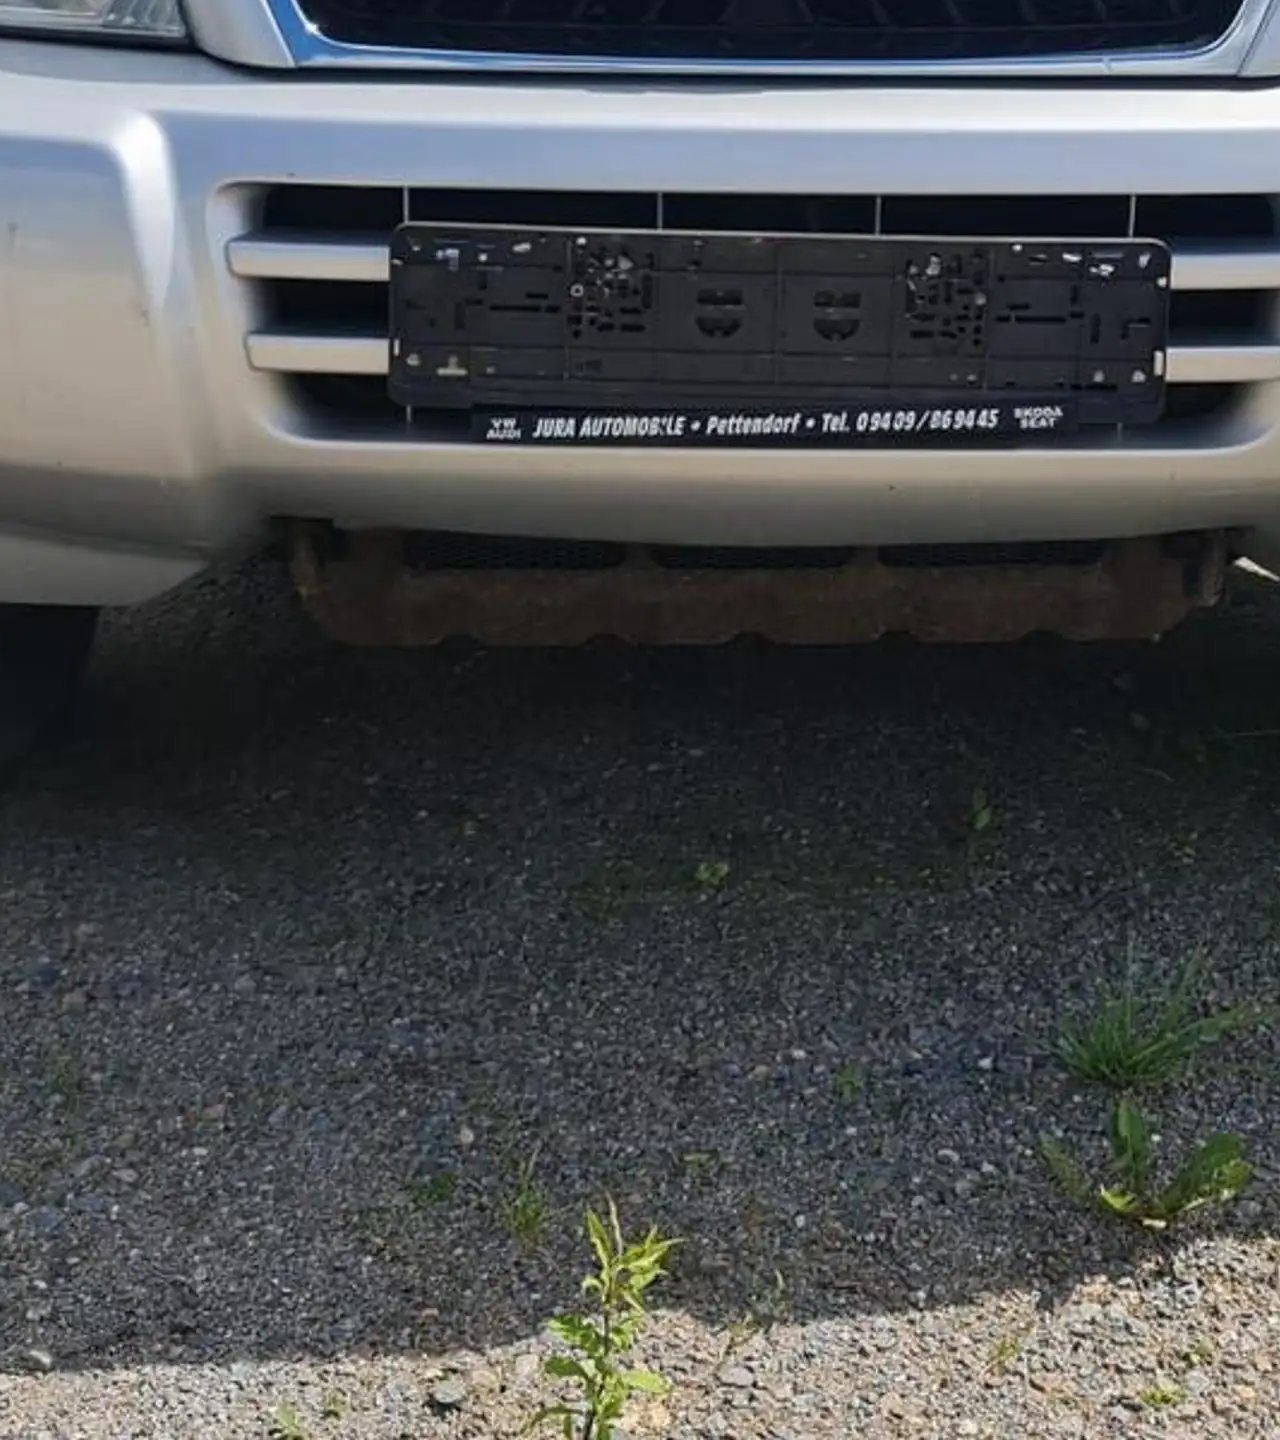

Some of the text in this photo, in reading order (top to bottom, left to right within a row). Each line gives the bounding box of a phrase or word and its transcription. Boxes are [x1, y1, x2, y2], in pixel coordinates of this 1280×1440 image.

[532, 417, 576, 438] JURA
[706, 413, 801, 435] Pettendorf
[822, 412, 850, 433] Tel.
[1020, 417, 1056, 428] SEAT
[486, 428, 521, 439] AUDI
